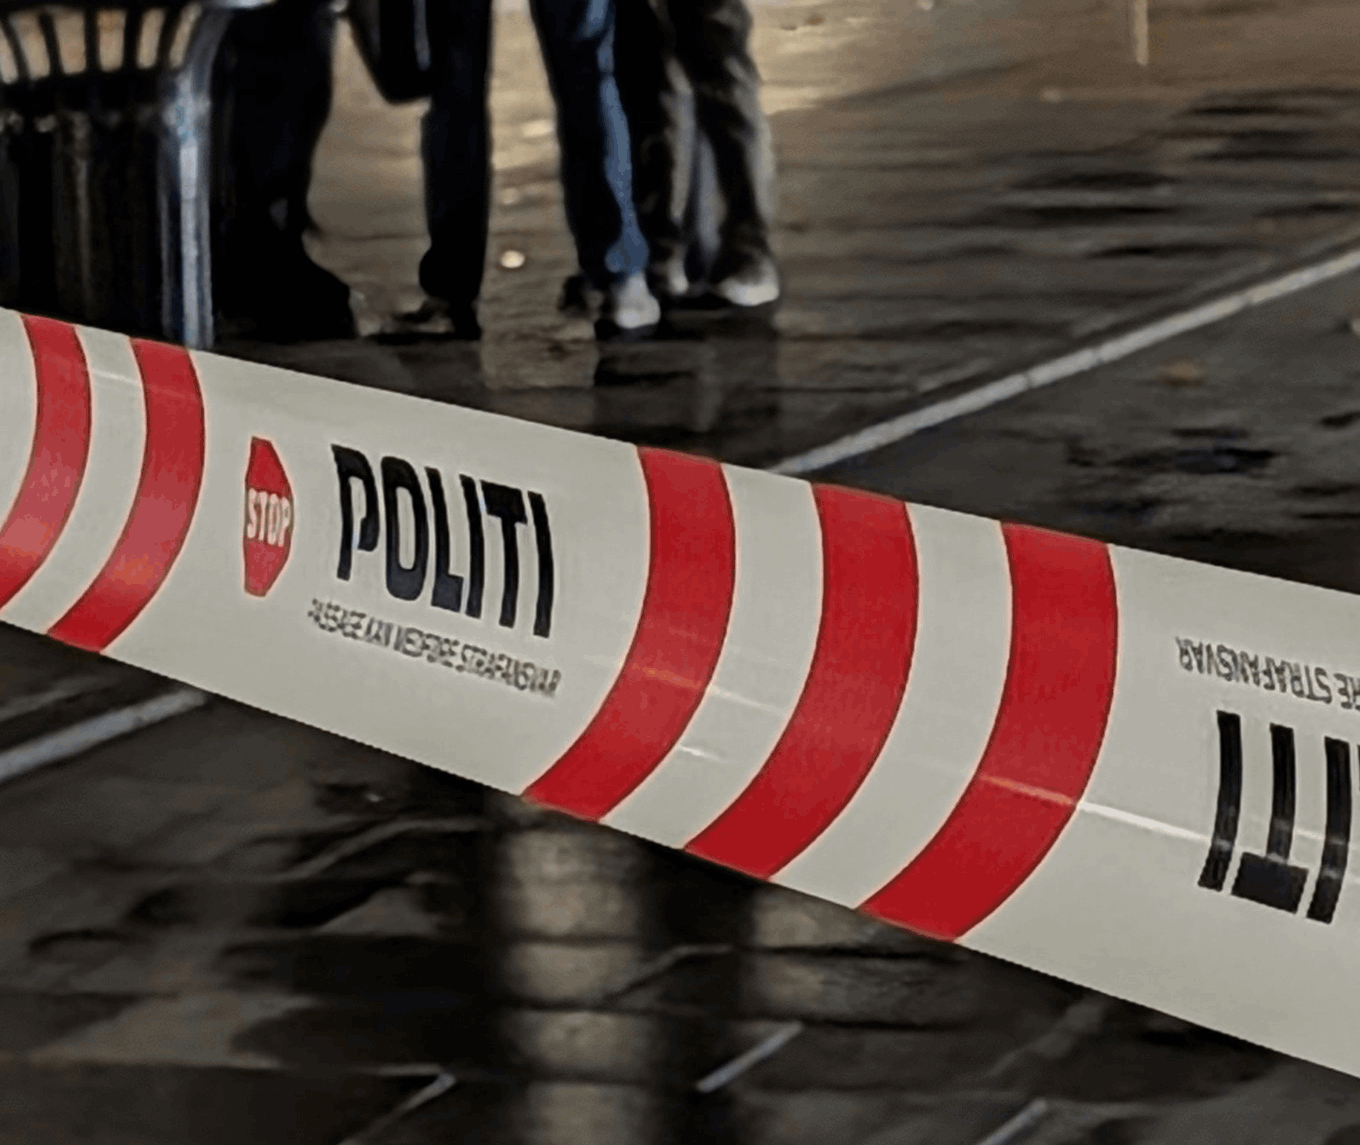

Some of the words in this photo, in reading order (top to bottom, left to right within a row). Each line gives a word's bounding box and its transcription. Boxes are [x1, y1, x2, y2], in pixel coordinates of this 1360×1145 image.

[246, 488, 291, 548] STOP
[331, 443, 555, 638] POLITI
[1174, 636, 1333, 705] STRAFANSVAR
